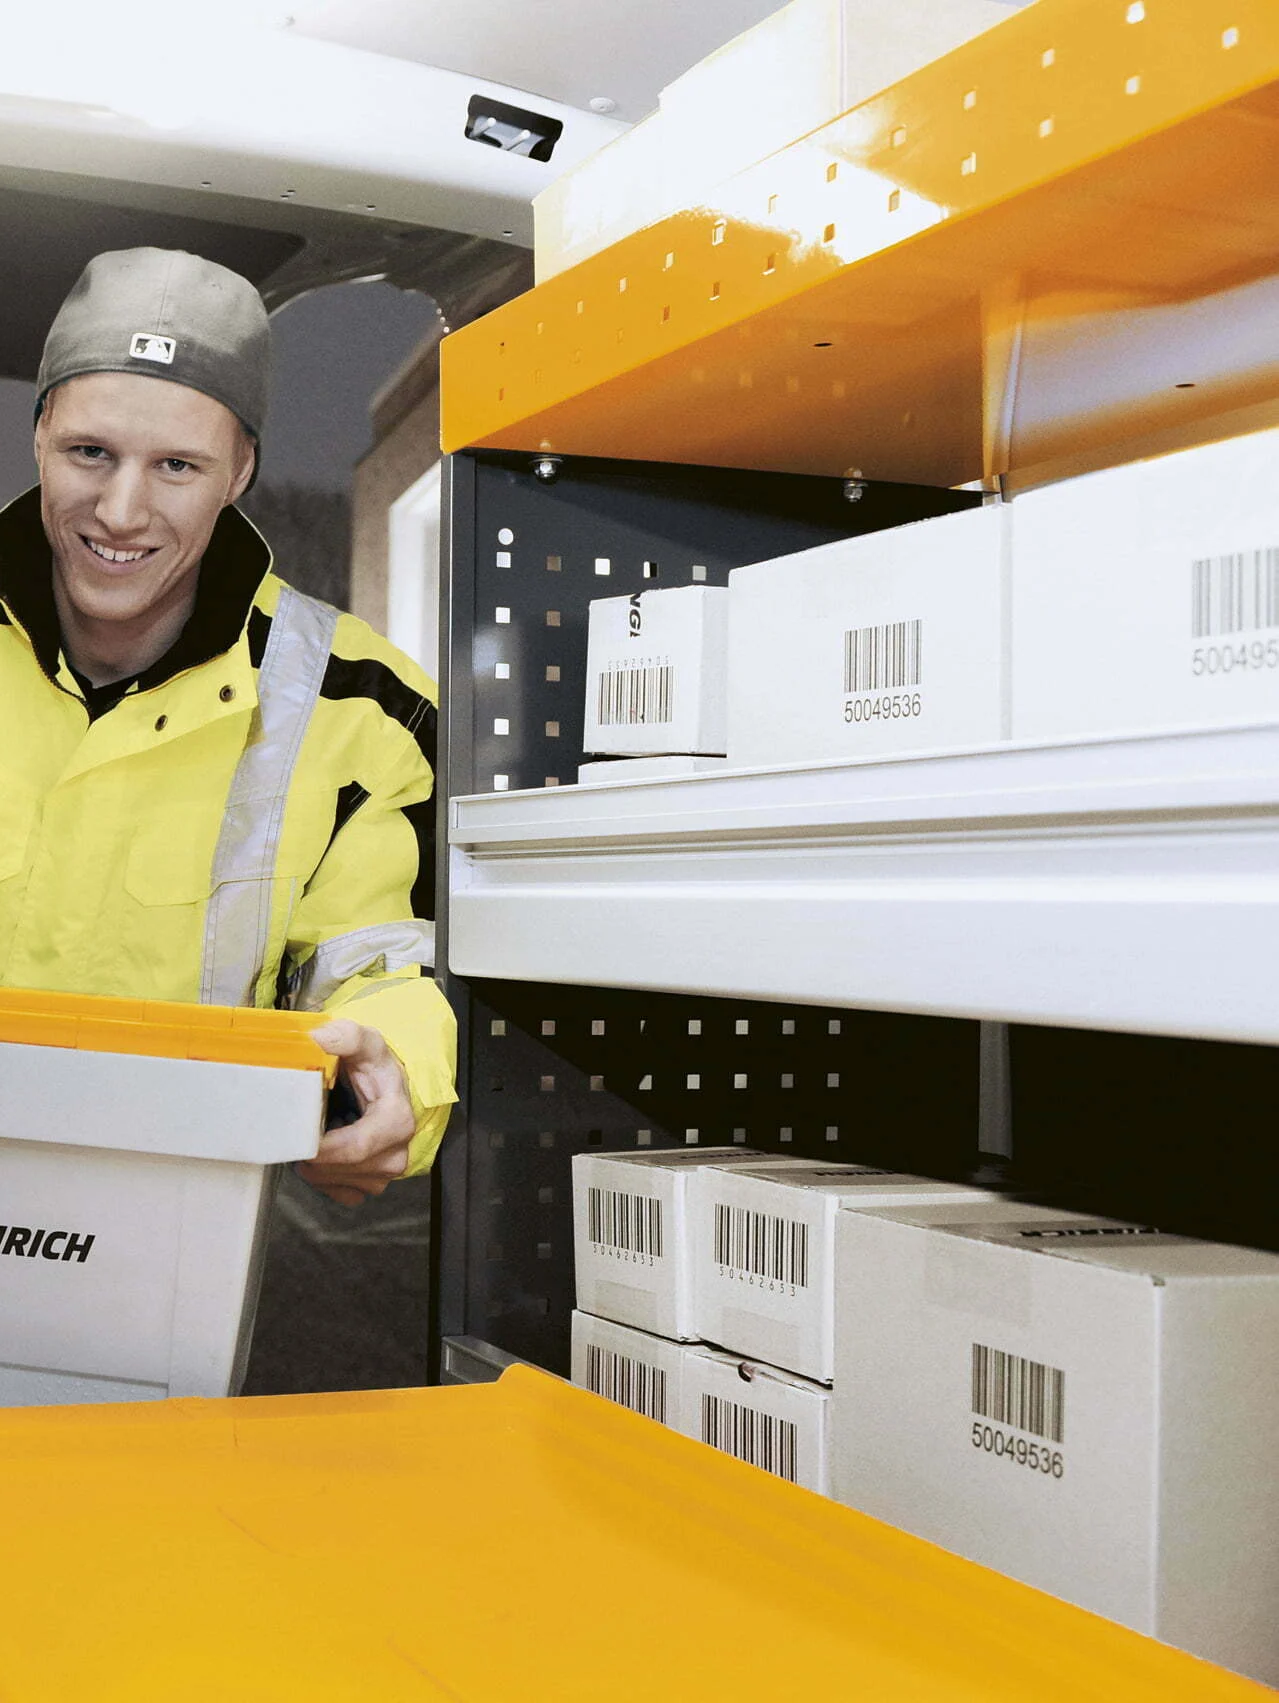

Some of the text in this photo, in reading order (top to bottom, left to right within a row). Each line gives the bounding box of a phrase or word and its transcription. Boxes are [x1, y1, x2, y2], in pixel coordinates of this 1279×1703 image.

[844, 693, 921, 723] 50049536
[593, 1244, 654, 1267] 50462653
[720, 1266, 796, 1297] 50462653
[972, 1422, 1064, 1479] 50049536
